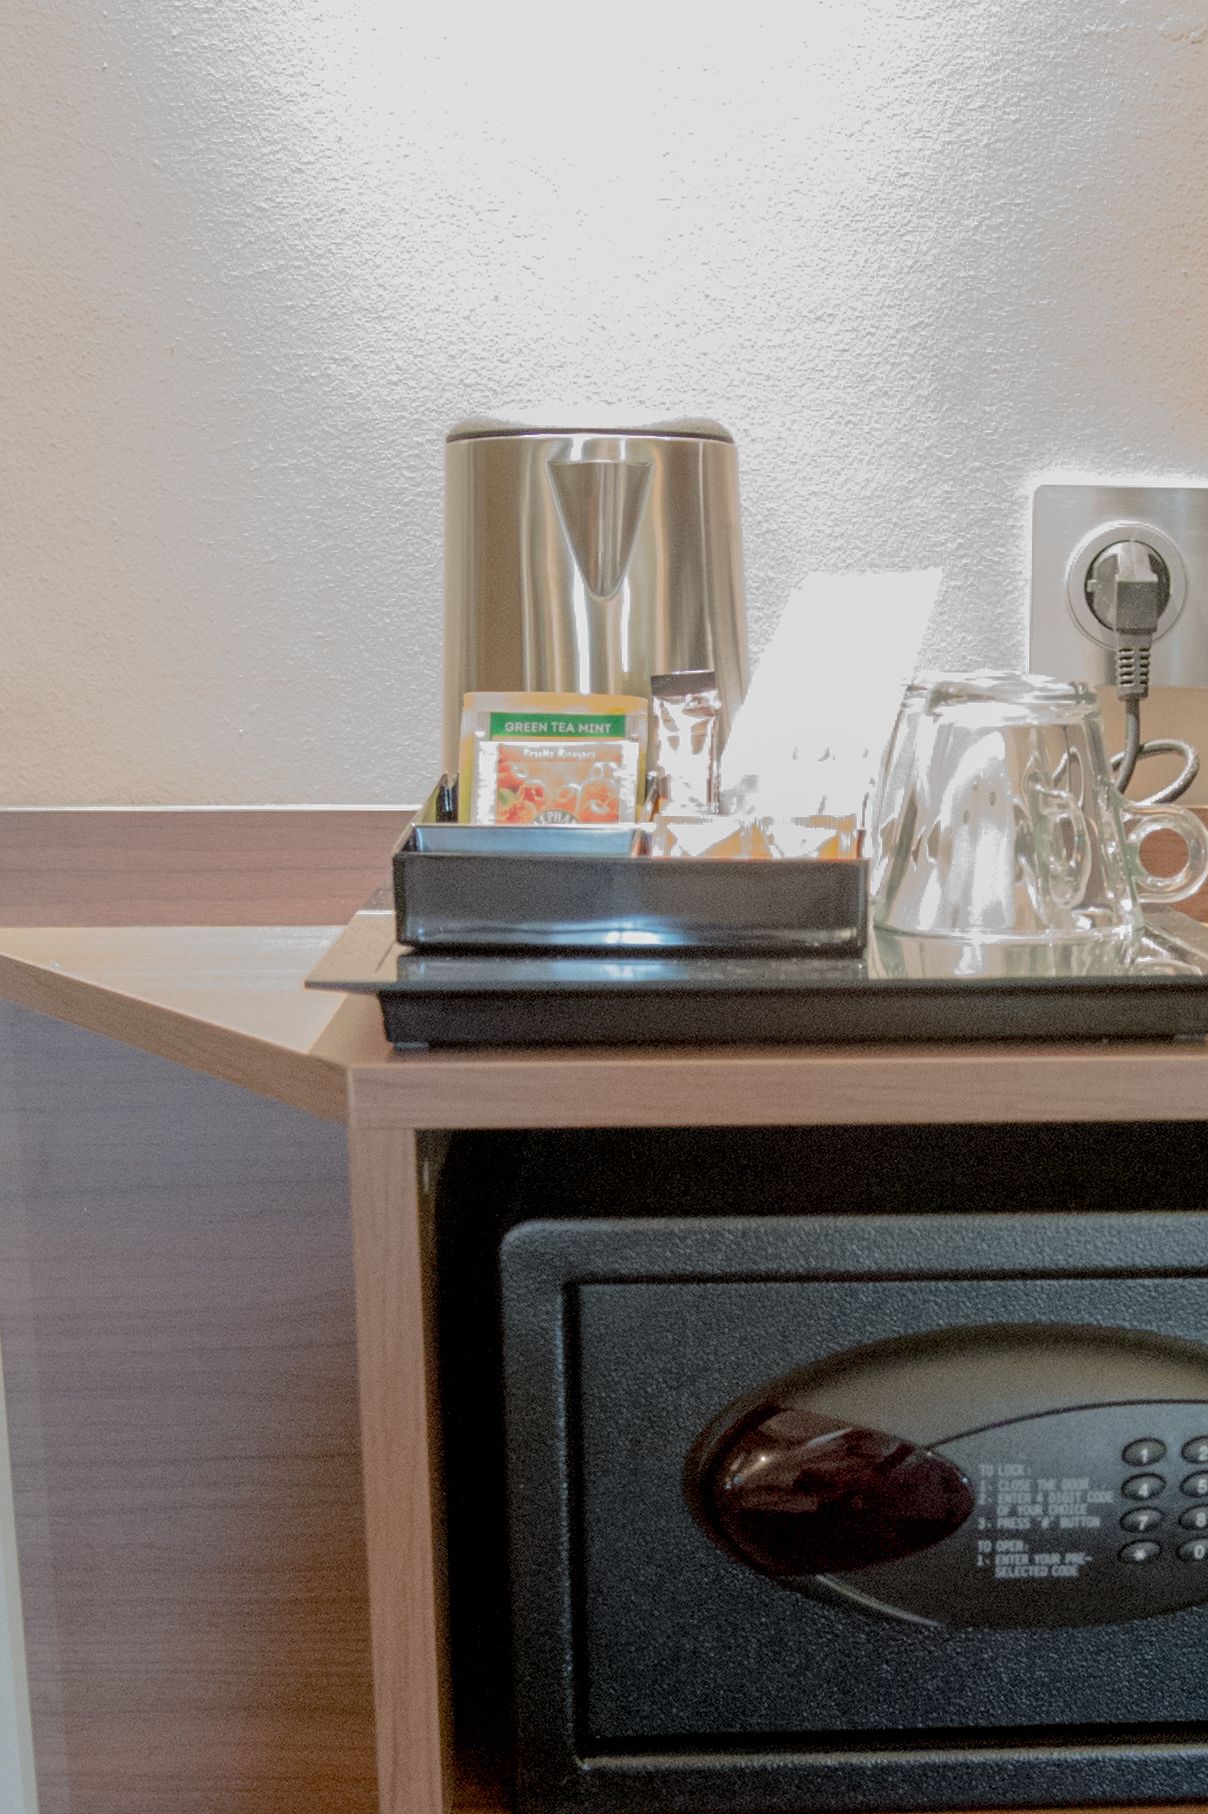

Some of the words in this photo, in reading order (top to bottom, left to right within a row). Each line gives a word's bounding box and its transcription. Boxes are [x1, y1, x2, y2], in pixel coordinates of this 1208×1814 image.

[504, 721, 548, 732] GREEN
[551, 721, 575, 733] TEA
[578, 722, 612, 734] MINT
[1140, 1448, 1149, 1463] 1
[1198, 1445, 1208, 1462] 2
[1138, 1483, 1149, 1498] 4
[1198, 1479, 1208, 1494] 5
[1138, 1515, 1148, 1531] 7
[1196, 1512, 1206, 1528] 8
[1194, 1545, 1205, 1559] 0
